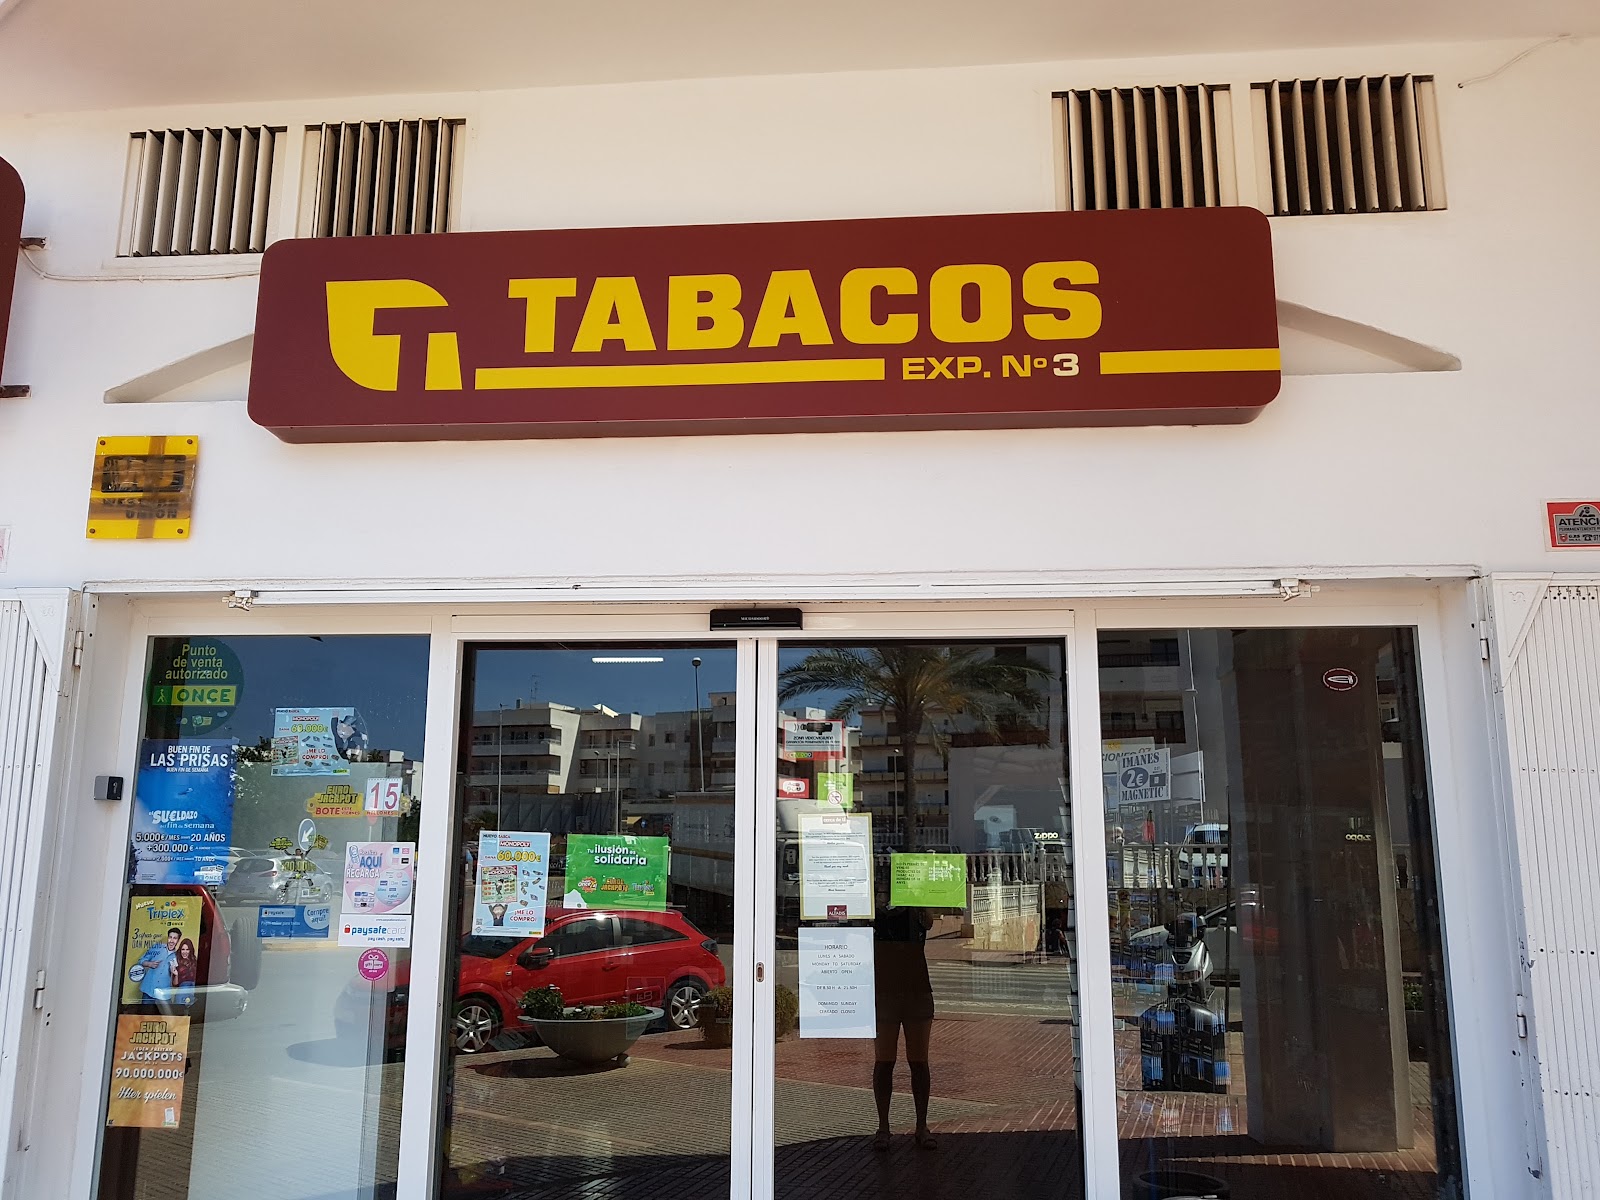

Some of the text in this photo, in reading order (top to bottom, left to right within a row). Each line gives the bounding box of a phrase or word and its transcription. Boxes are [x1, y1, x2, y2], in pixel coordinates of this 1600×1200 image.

[508, 260, 1102, 353] TABACOS
[902, 356, 991, 380] EXP.
[182, 644, 217, 656] Punto
[173, 656, 223, 668] de venta
[165, 668, 228, 680] autorizado
[176, 688, 232, 703] ONCE
[168, 745, 188, 754] BUEN
[150, 753, 229, 767] LAS PRISAS
[1122, 751, 1160, 769] IMANES
[1126, 769, 1144, 787] 2€
[326, 785, 351, 795] EURO
[370, 782, 400, 810] 15
[1121, 786, 1164, 801] MAGNETIC
[317, 793, 358, 804] JACKPOT
[315, 807, 341, 815] BOTE
[190, 833, 201, 842] 20
[203, 831, 226, 842] AÑOS
[594, 844, 629, 854] ilusión
[360, 853, 383, 870] AQUÍ
[497, 851, 541, 862] 60.000€
[594, 854, 647, 865] solidaria
[346, 868, 380, 878] RECARGA
[147, 906, 185, 920] Triplex
[132, 928, 140, 940] 3
[351, 925, 407, 936] paysafecard
[141, 1021, 168, 1032] EURO
[130, 1032, 176, 1046] JACKPOT
[121, 1051, 183, 1062] JACKPOTS
[143, 1087, 177, 1104] spielen
